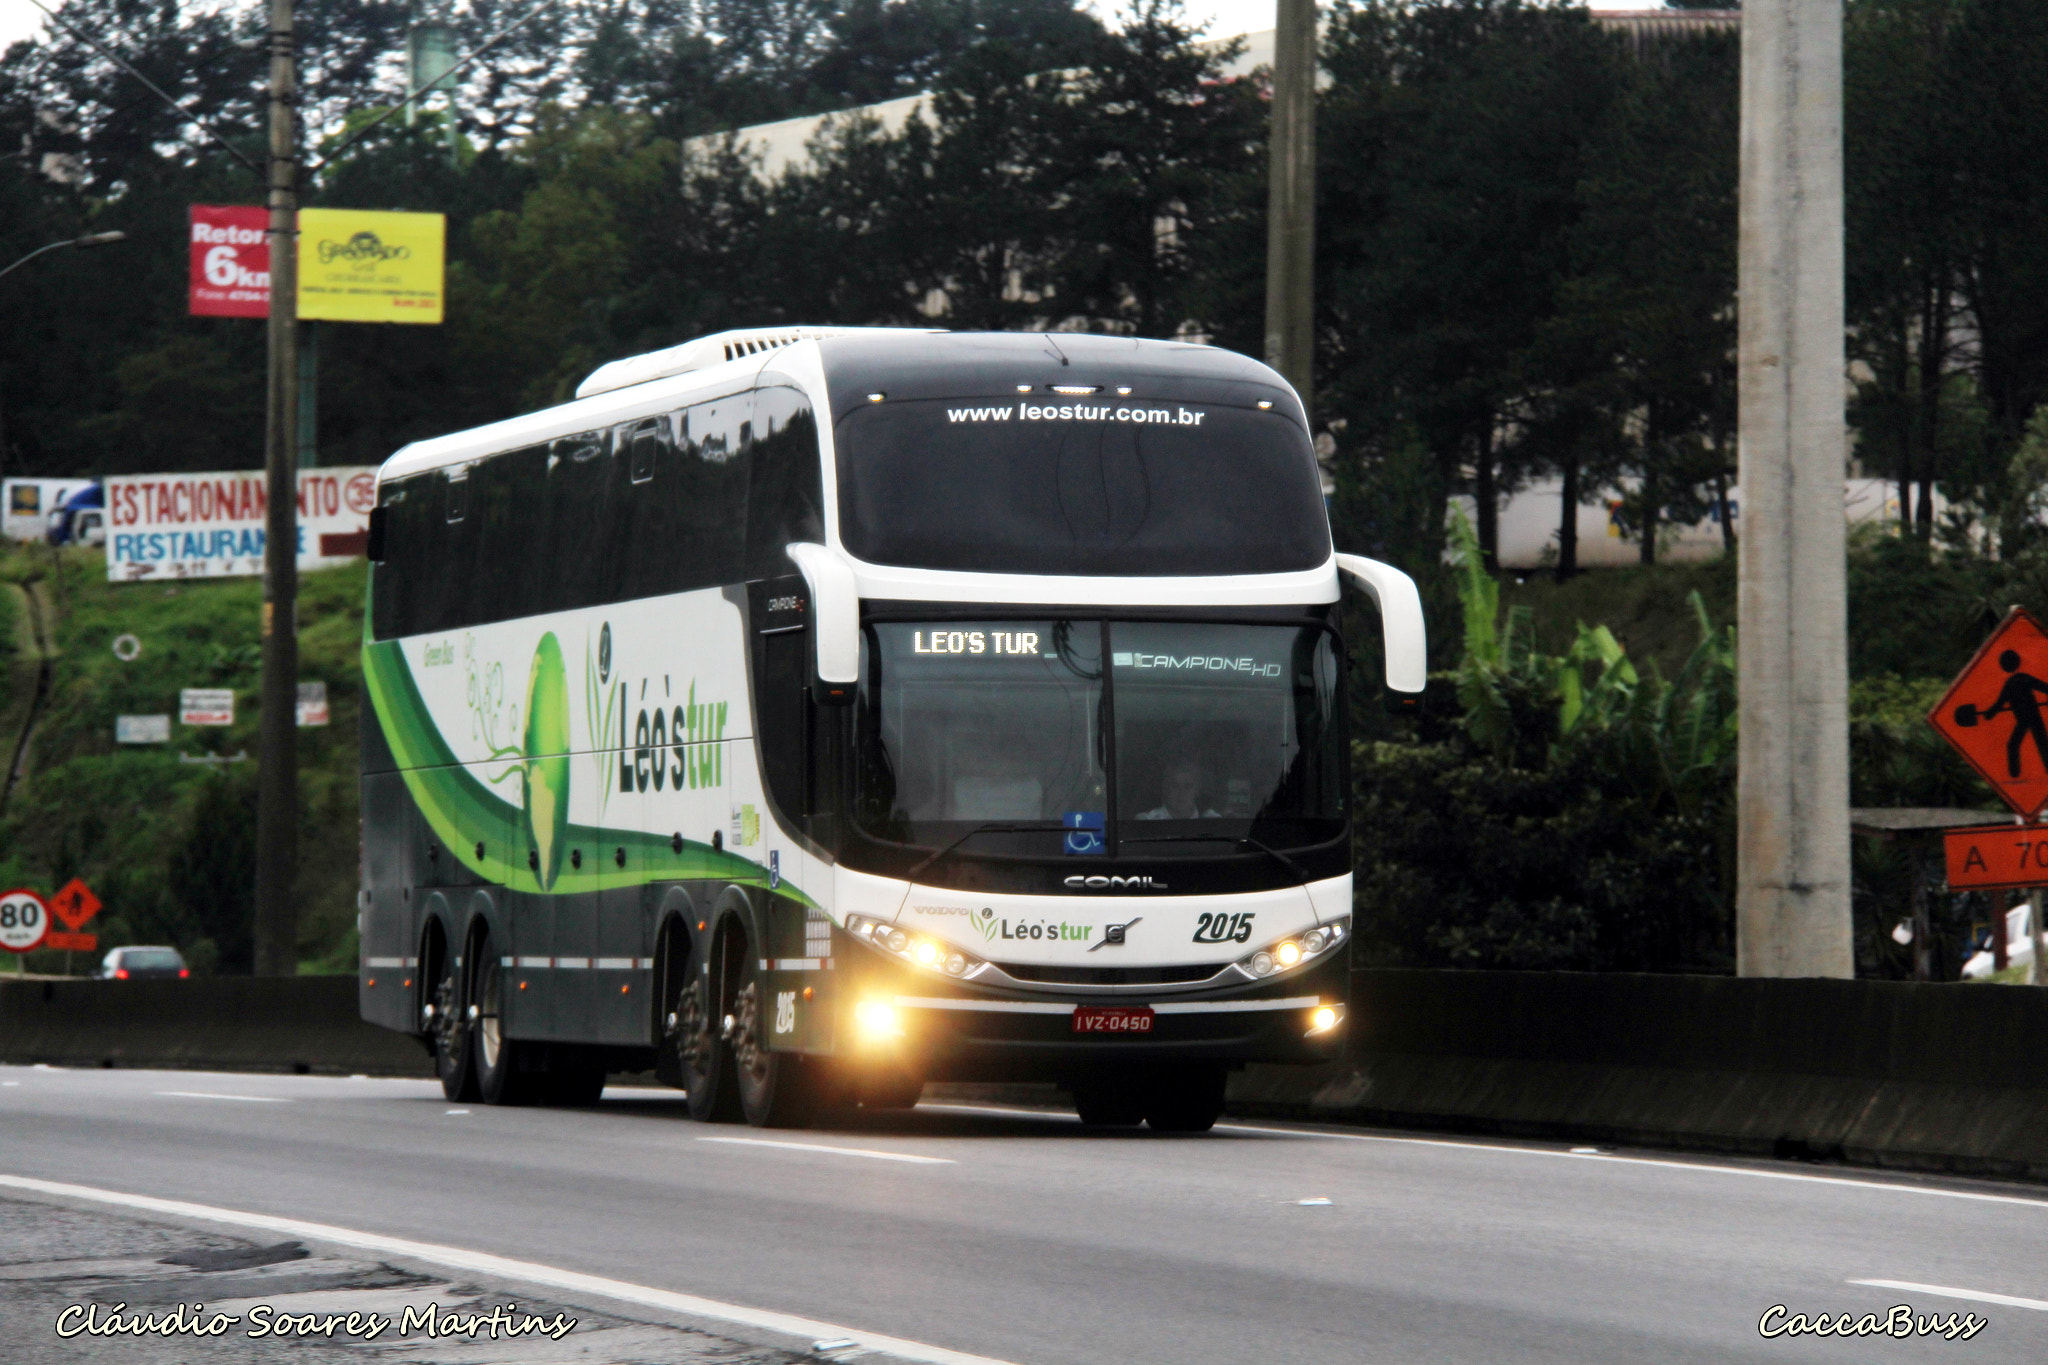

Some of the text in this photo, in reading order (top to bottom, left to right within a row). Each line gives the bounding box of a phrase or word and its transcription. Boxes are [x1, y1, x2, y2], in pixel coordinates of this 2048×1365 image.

[192, 222, 299, 245] Retor
[947, 403, 1205, 425] www leostur.com.br
[110, 476, 340, 526] ESTACIONAMNTO
[115, 526, 307, 562] RESTAURANE
[914, 631, 1039, 654] LEO'S TUR
[1963, 846, 1989, 873] A
[1064, 875, 1168, 889] COMIL
[1, 903, 39, 928] 80
[1192, 912, 1256, 944] 2015
